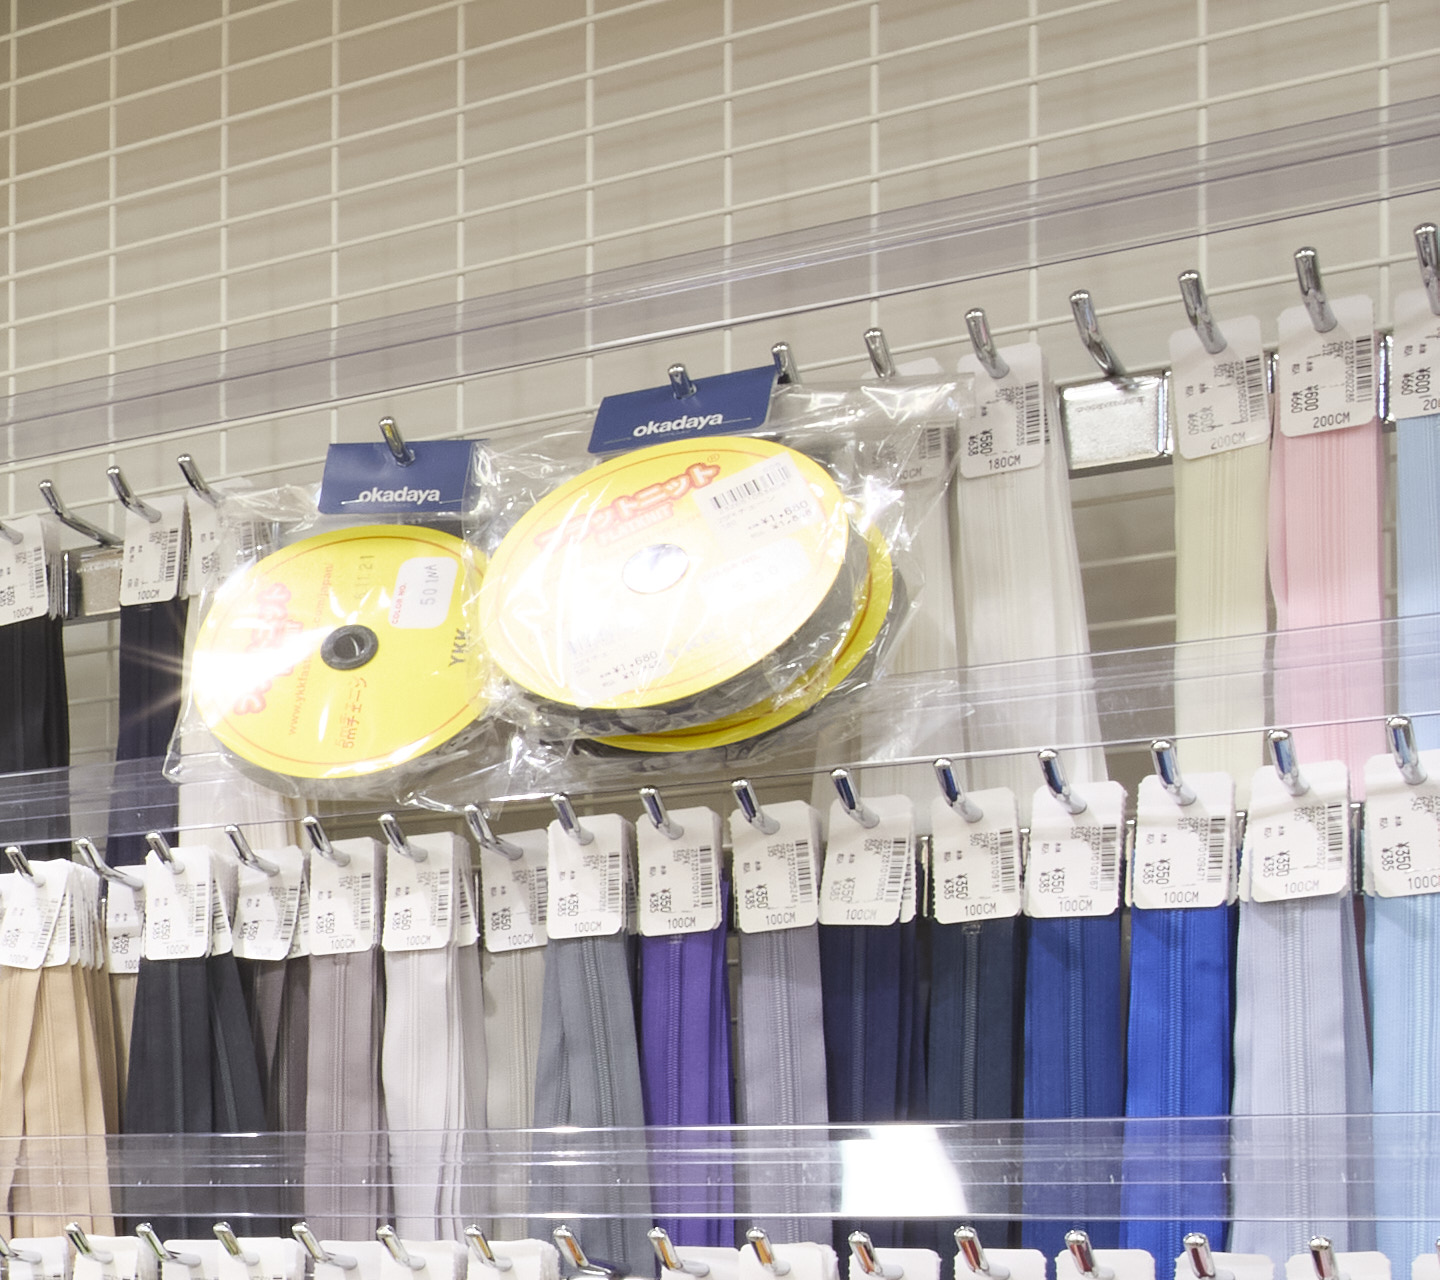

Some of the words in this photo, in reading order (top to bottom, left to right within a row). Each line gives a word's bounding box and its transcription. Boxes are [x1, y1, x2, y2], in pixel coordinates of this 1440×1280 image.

[1416, 366, 1431, 394] ¥600
[1304, 384, 1319, 412] ¥600
[633, 413, 723, 437] okadaya
[1313, 413, 1351, 429] 200CM
[980, 428, 993, 455] ¥580
[988, 454, 1021, 470] 180CM
[358, 486, 441, 505] okadaya
[448, 627, 467, 668] YKK
[757, 883, 768, 909] ¥350
[1284, 880, 1319, 895] 100CM
[568, 893, 579, 917] ¥350
[661, 888, 672, 913] ¥350
[1058, 898, 1095, 913] 100CM
[1163, 891, 1199, 904] 100CM
[965, 903, 997, 916] 100CM
[501, 906, 512, 931] ¥350
[574, 922, 602, 932] 100CM
[668, 917, 696, 929] 100CM
[765, 912, 796, 925] 100CM
[508, 935, 534, 946] 100CM
